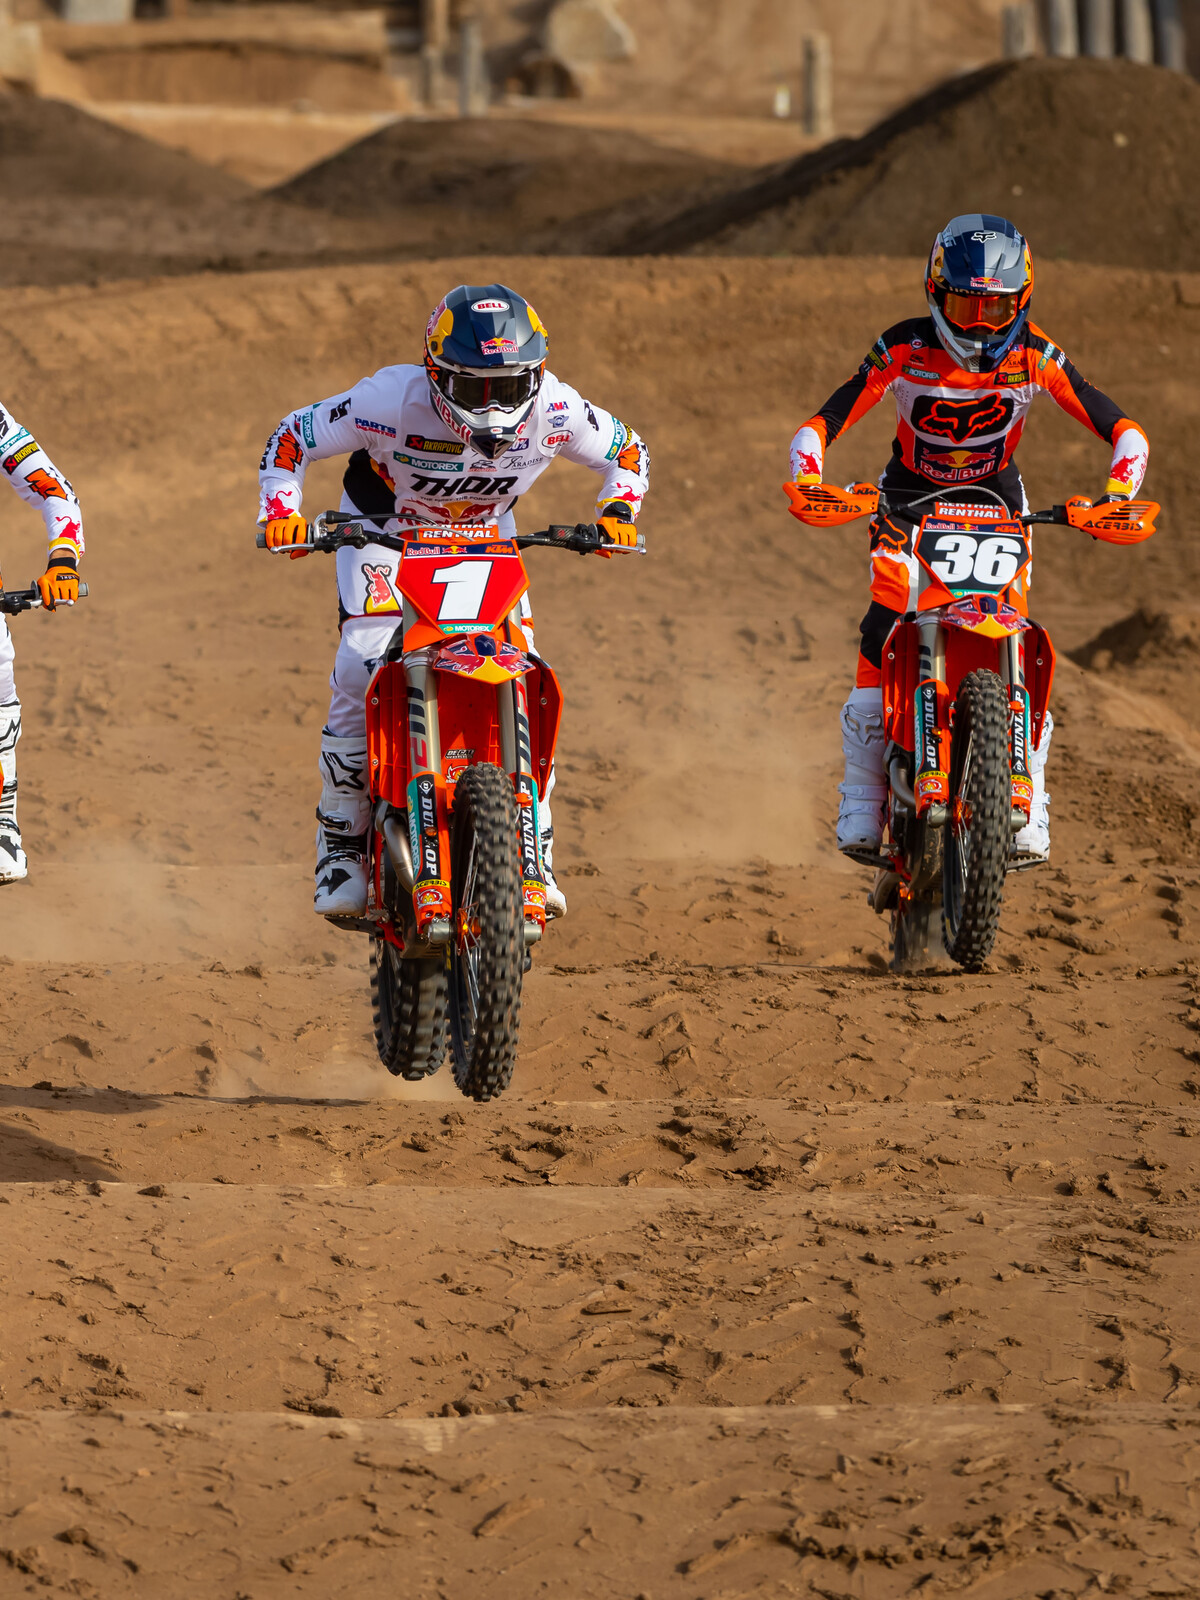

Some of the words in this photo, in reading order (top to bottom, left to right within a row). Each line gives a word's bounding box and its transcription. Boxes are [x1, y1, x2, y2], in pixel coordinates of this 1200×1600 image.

[477, 302, 504, 310] BELL
[908, 368, 940, 380] MOTOREX
[546, 401, 568, 412] AMA
[355, 418, 396, 434] PARTS
[441, 404, 472, 443] Bull
[412, 458, 458, 470] MOTOREX
[920, 460, 958, 480] Red
[958, 460, 995, 480] Bull
[410, 473, 518, 496] THOR
[856, 488, 878, 496] KTM
[802, 504, 862, 514] ACERBIS
[1068, 500, 1092, 508] KTM
[938, 508, 1002, 519] RENTHAL
[926, 522, 940, 530] Red
[994, 525, 1020, 534] KTM
[1082, 520, 1144, 532] ACERBIS
[422, 530, 494, 538] RENTHAL
[407, 548, 423, 556] Red
[485, 544, 513, 554] KTM
[930, 534, 1022, 585] 36
[431, 560, 494, 621] 1
[1014, 690, 1025, 760] DUNLP
[520, 782, 536, 862] DUNLP
[422, 796, 438, 876] DUOP
[408, 812, 422, 874] MOTOREX
